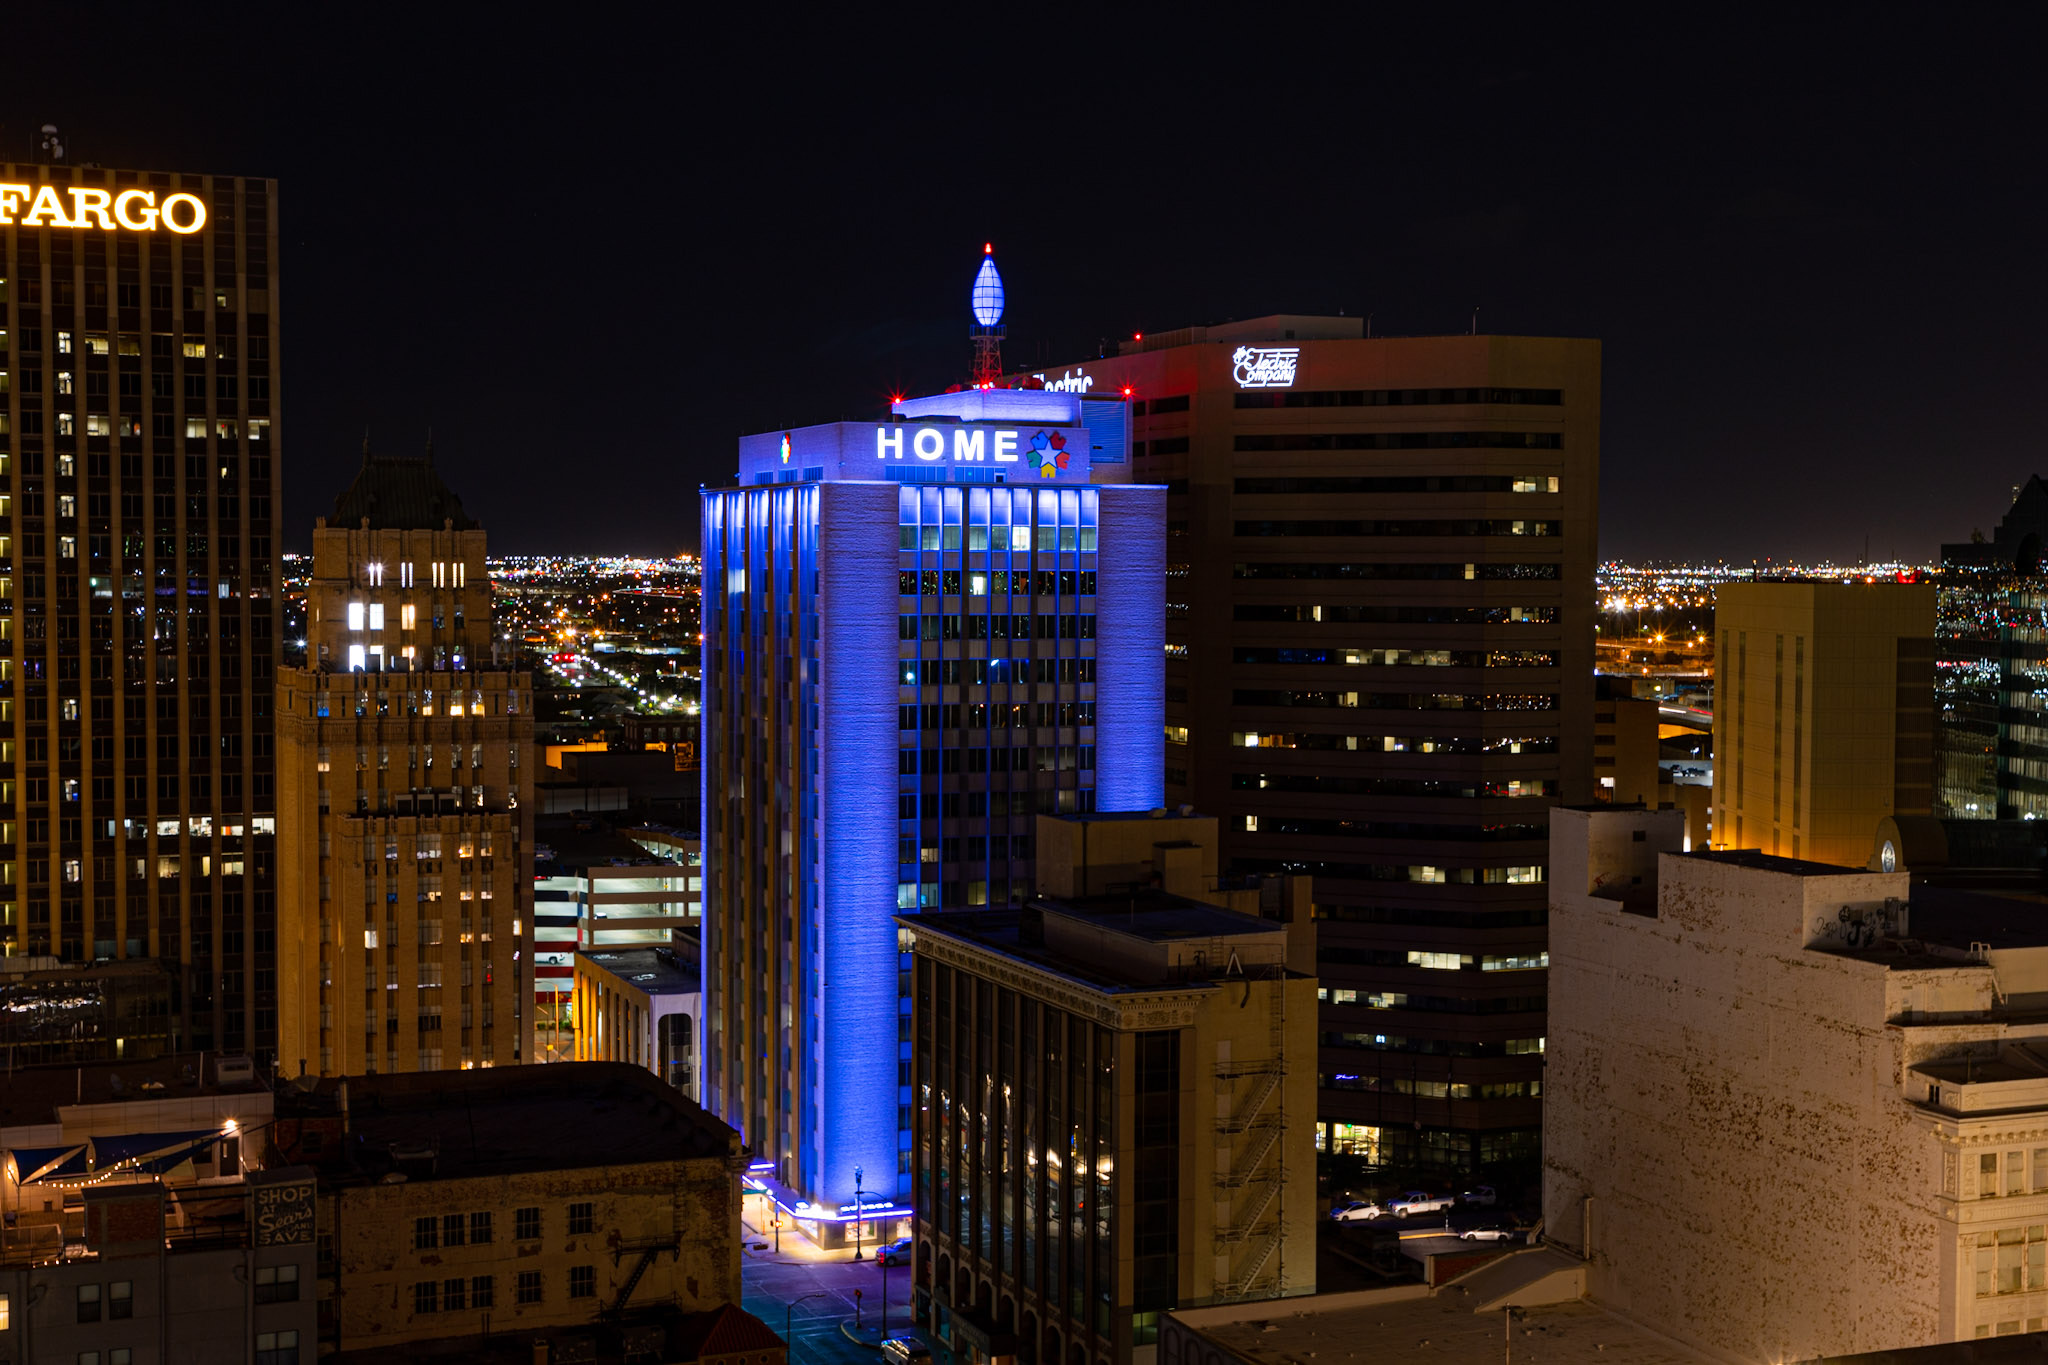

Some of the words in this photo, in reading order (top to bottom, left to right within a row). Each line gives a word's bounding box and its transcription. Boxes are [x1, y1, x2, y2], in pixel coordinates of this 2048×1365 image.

[0, 184, 206, 234] FARGO
[1244, 348, 1300, 373] Electric
[1233, 362, 1297, 389] Company
[877, 427, 1019, 462] HOME
[258, 1187, 312, 1205] SHOP
[258, 1207, 313, 1234] Sears
[262, 1204, 276, 1214] AT
[258, 1231, 312, 1245] SAVE
[294, 1222, 312, 1231] AND
